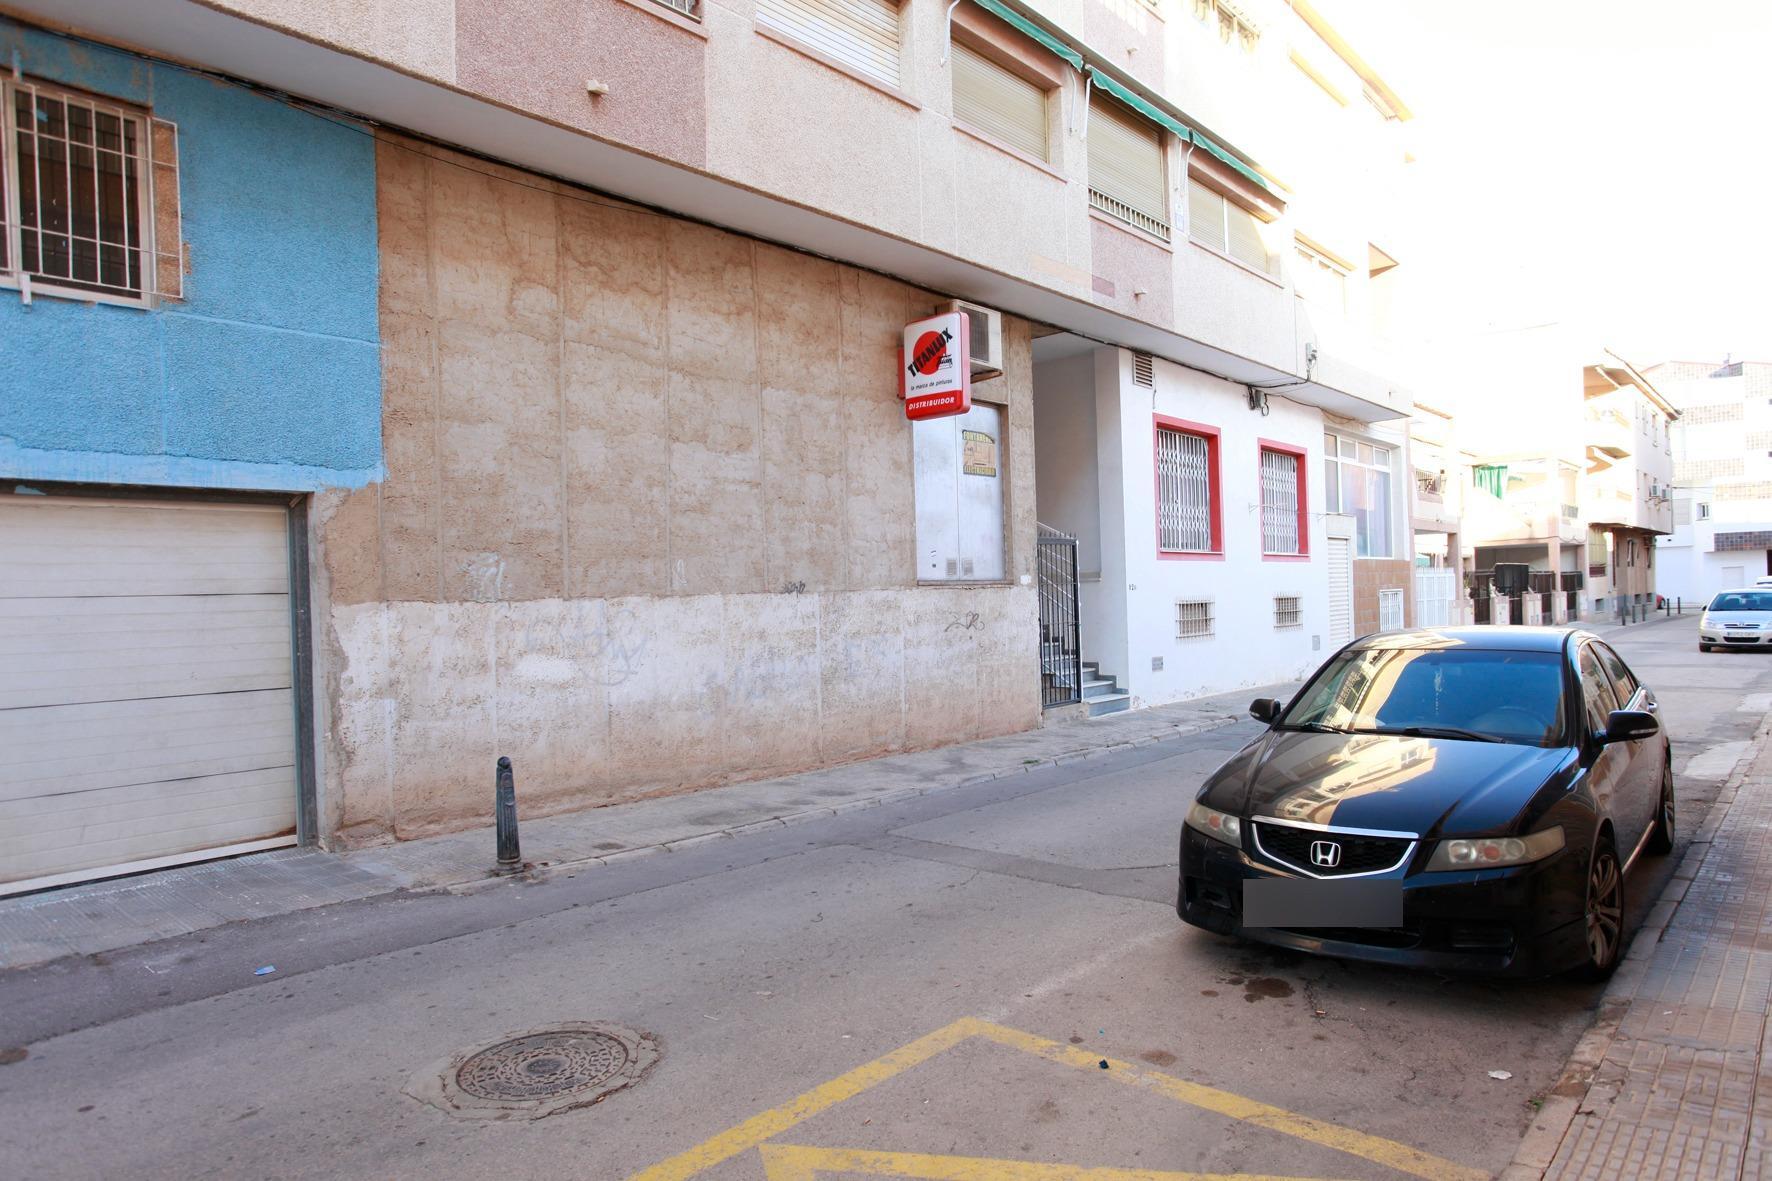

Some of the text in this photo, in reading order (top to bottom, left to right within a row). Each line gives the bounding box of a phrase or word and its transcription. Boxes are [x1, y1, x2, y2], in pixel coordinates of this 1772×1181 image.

[907, 327, 953, 377] TITANLUX
[935, 379, 952, 387] pinturas
[908, 397, 955, 410] DISTRIBUIDOR
